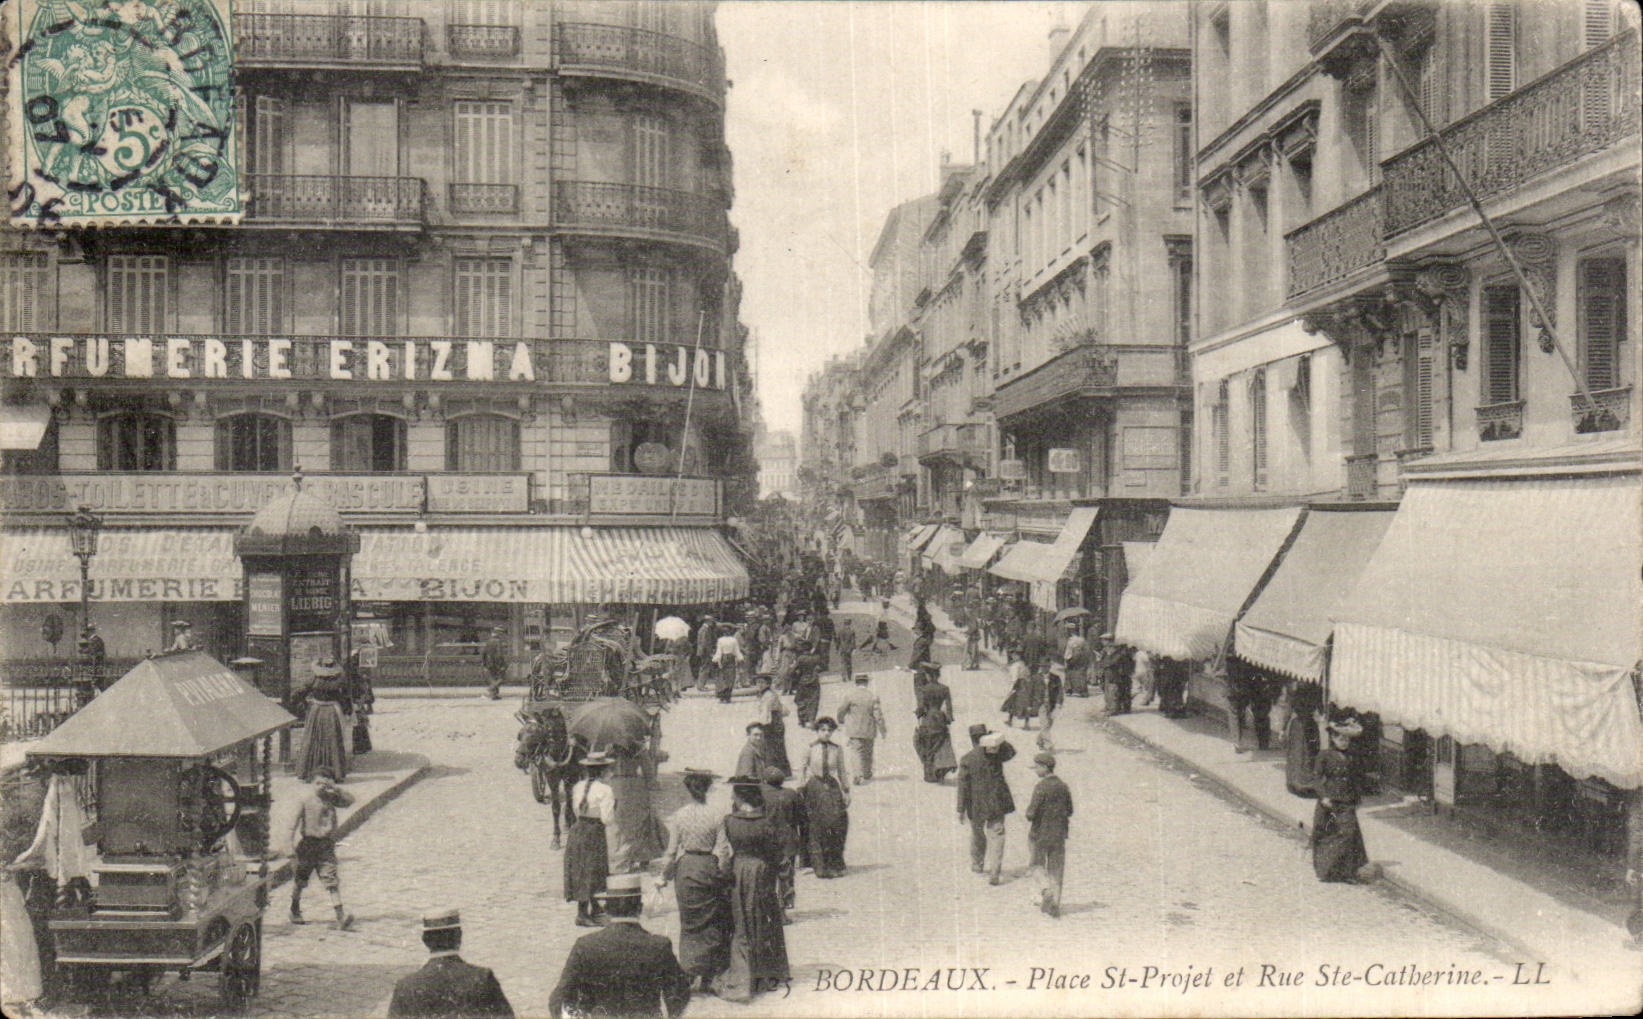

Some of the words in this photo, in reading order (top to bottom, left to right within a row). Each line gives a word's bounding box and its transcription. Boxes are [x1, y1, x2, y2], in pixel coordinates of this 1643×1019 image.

[86, 192, 164, 213] POSTE
[12, 337, 291, 378] RFUMERIE
[330, 340, 535, 382] ERIZMA
[609, 342, 725, 390] BIJON
[7, 577, 219, 600] ARFUMERIE
[291, 597, 332, 611] LIEBIG
